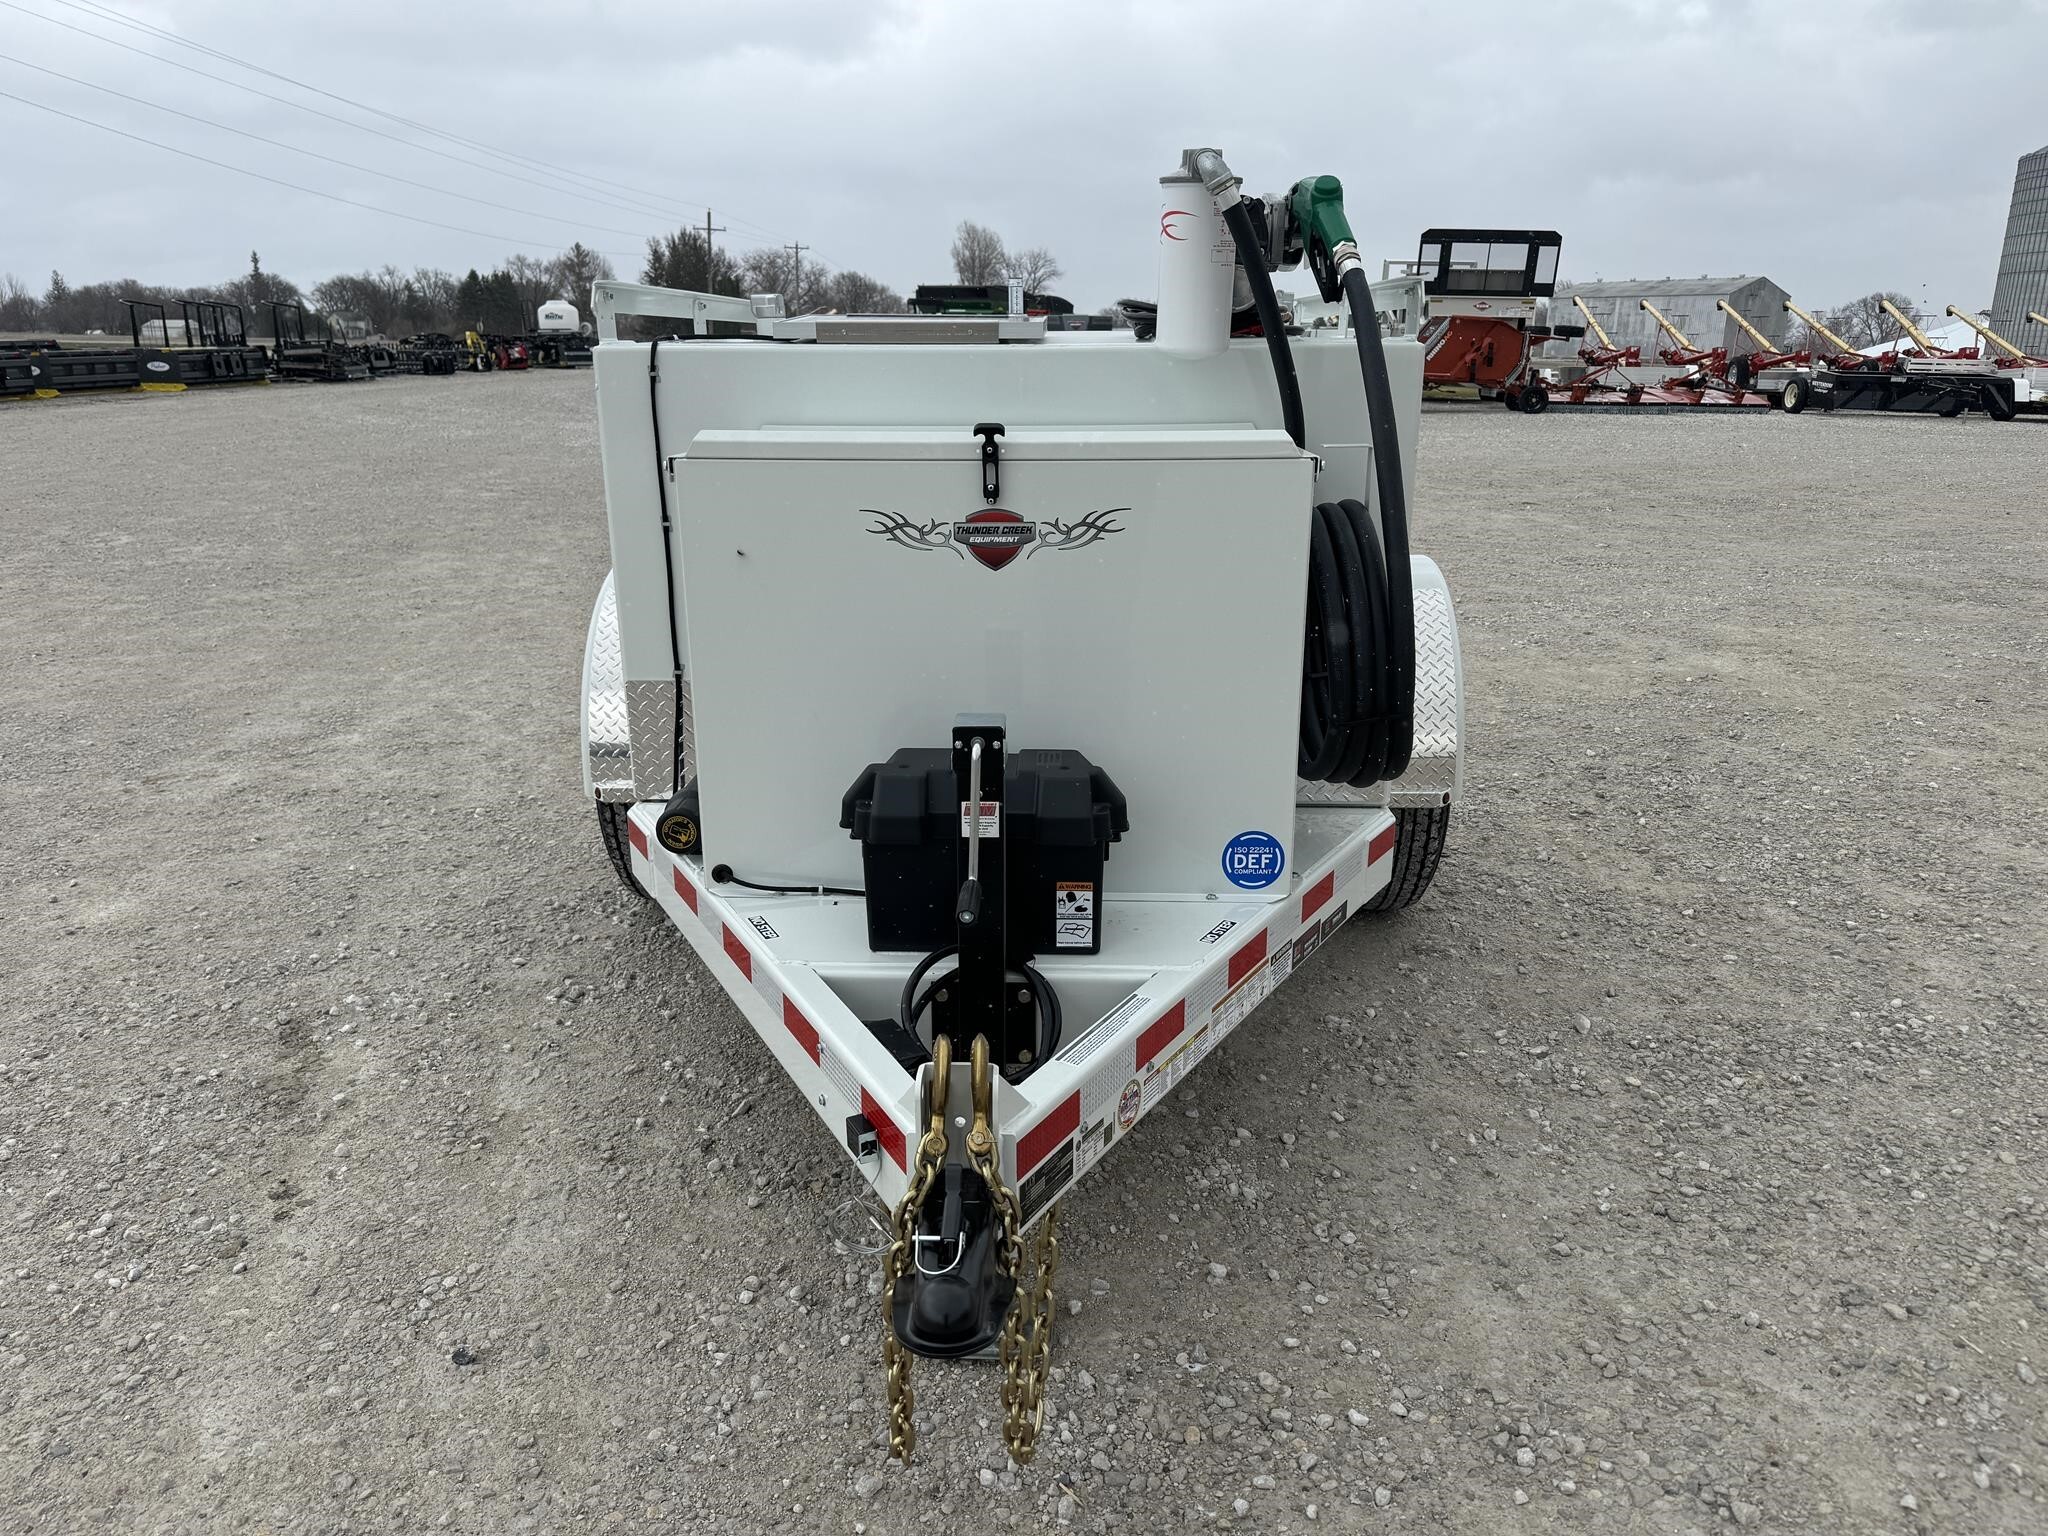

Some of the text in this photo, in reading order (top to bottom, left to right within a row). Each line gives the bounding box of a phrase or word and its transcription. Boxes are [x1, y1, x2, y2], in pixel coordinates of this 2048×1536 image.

[956, 526, 1034, 535] THUNDER CREEK
[1234, 854, 1273, 868] DEF
[756, 923, 778, 938] STEP
[1211, 920, 1232, 935] STEP
